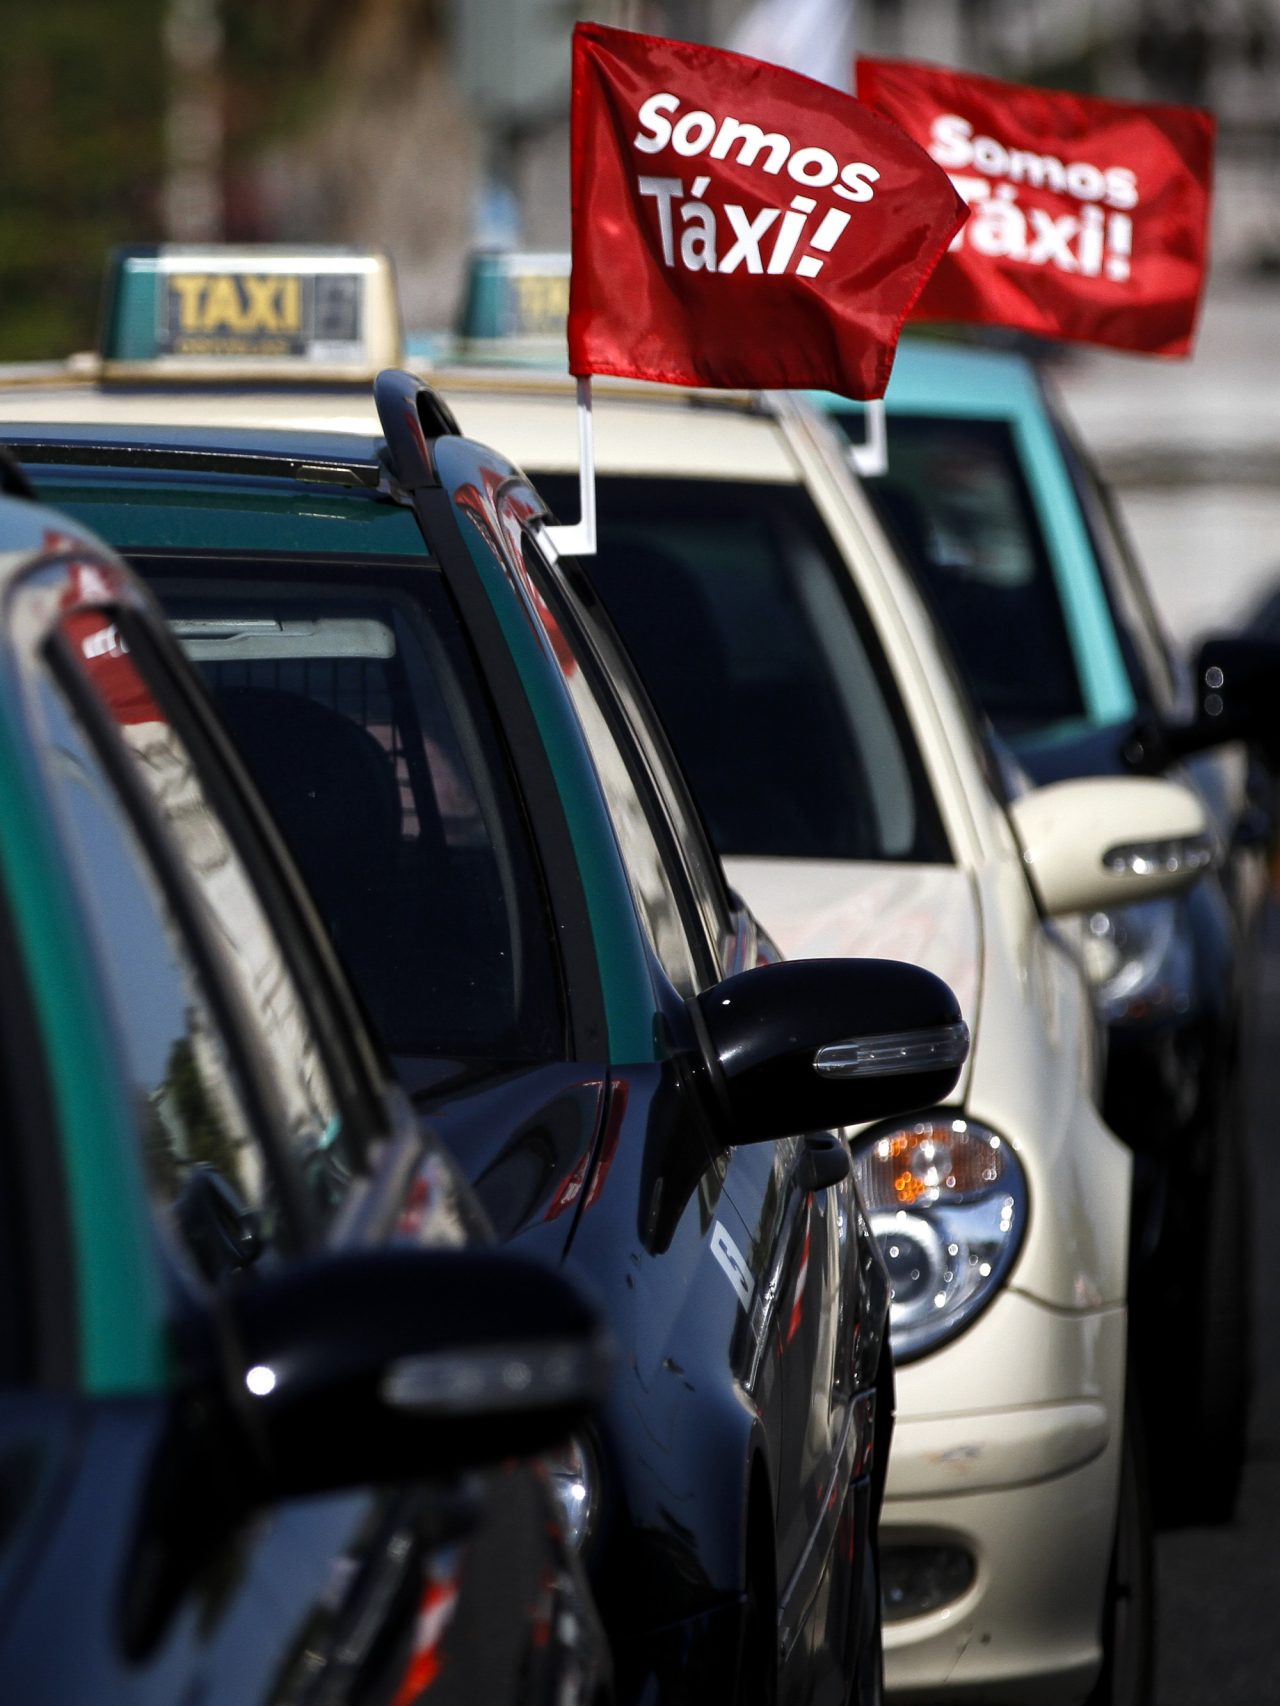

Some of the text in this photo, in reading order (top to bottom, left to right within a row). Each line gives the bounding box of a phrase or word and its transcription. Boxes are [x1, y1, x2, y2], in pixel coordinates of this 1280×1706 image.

[634, 93, 881, 203] Somos
[929, 113, 1139, 210] Somos
[637, 175, 852, 278] Táxi!
[172, 274, 299, 331] TAXI
